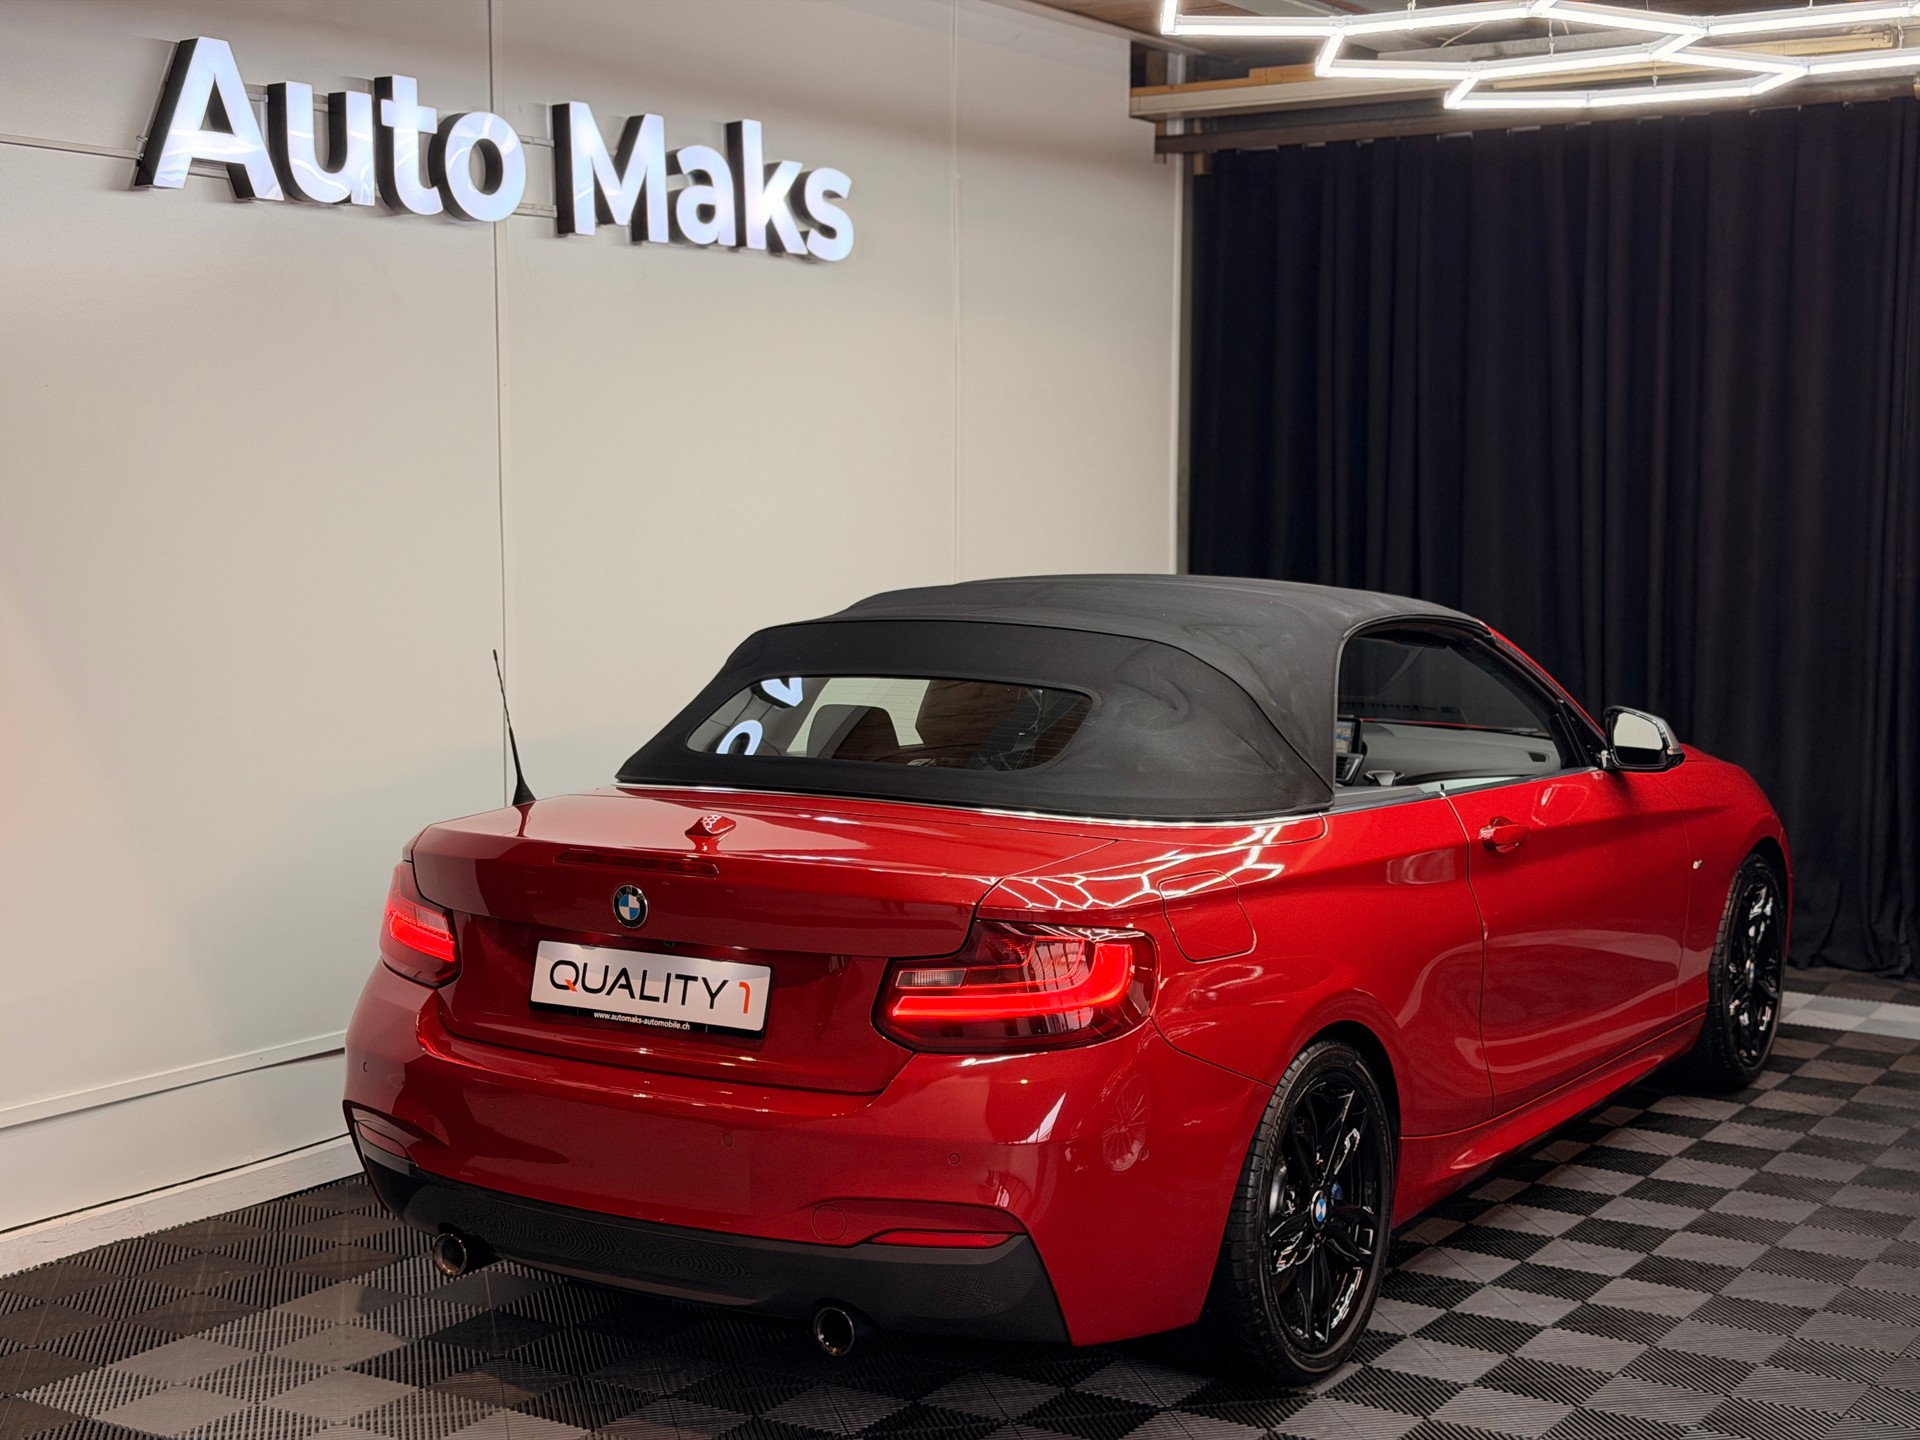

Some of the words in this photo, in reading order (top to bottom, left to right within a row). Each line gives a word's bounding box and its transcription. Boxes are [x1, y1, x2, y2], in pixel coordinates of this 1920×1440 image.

[148, 36, 526, 222] Auto
[556, 101, 854, 262] Maks
[550, 960, 729, 1009] QUALITY
[594, 1012, 690, 1030] www.automaks-automobile.ch
